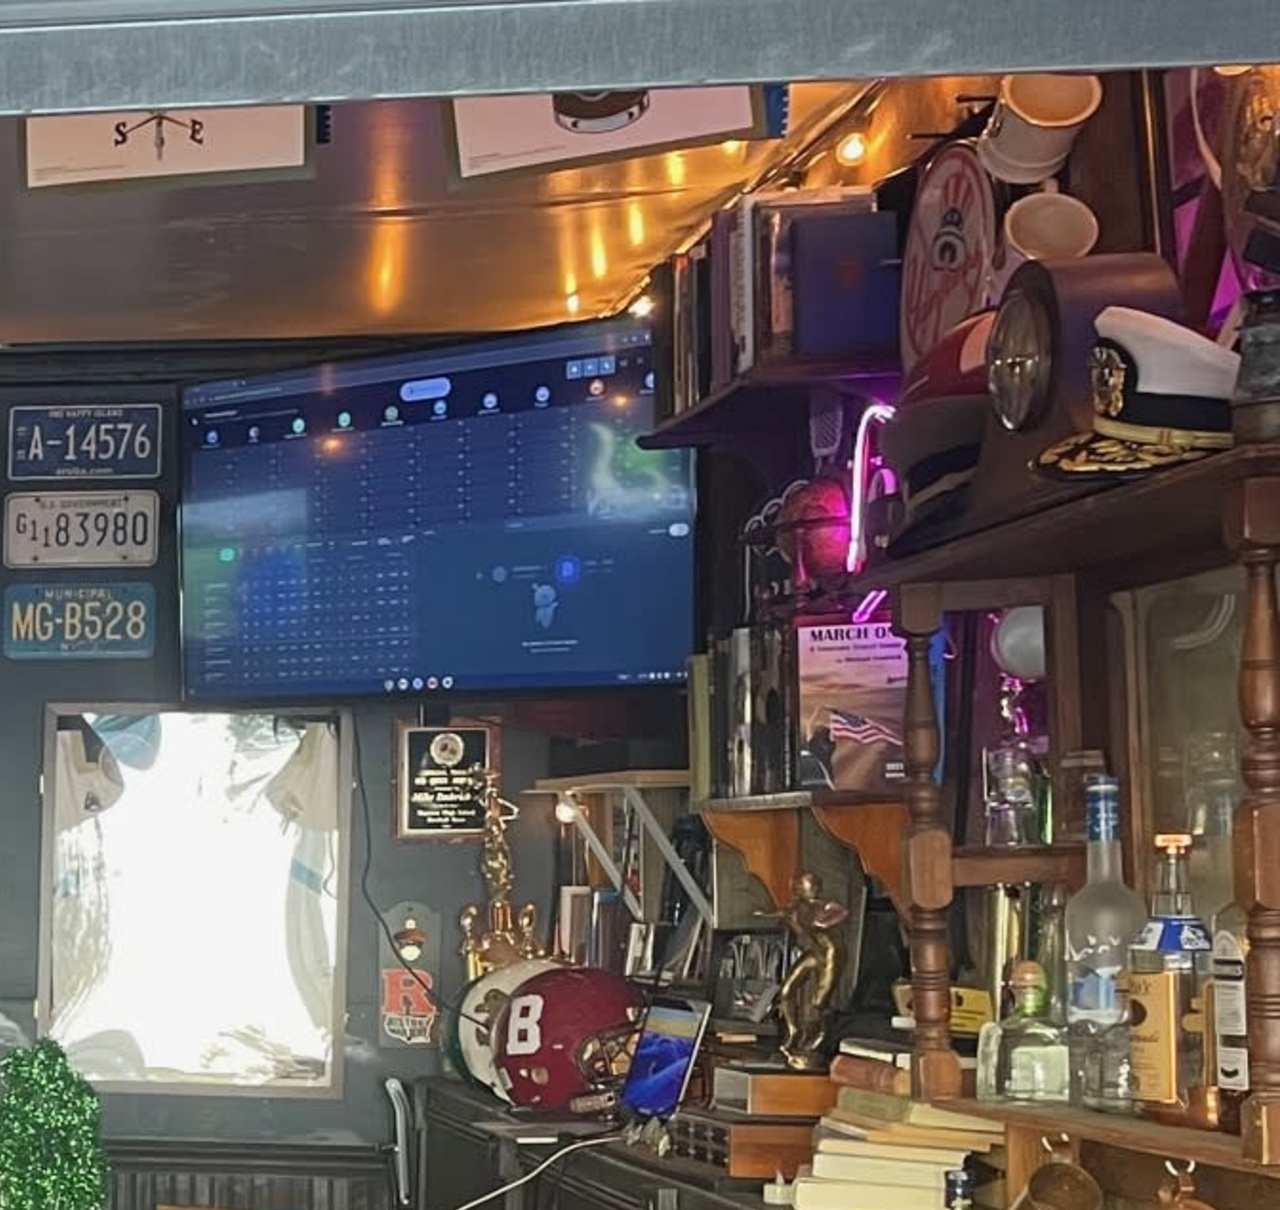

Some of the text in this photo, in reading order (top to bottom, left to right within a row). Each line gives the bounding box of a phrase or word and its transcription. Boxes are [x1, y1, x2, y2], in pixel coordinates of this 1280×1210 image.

[28, 422, 152, 461] A-14576
[44, 588, 112, 600] MUNICIPAL
[11, 600, 146, 641] MG-B528
[809, 626, 868, 642] MARCH
[506, 993, 546, 1056] B
